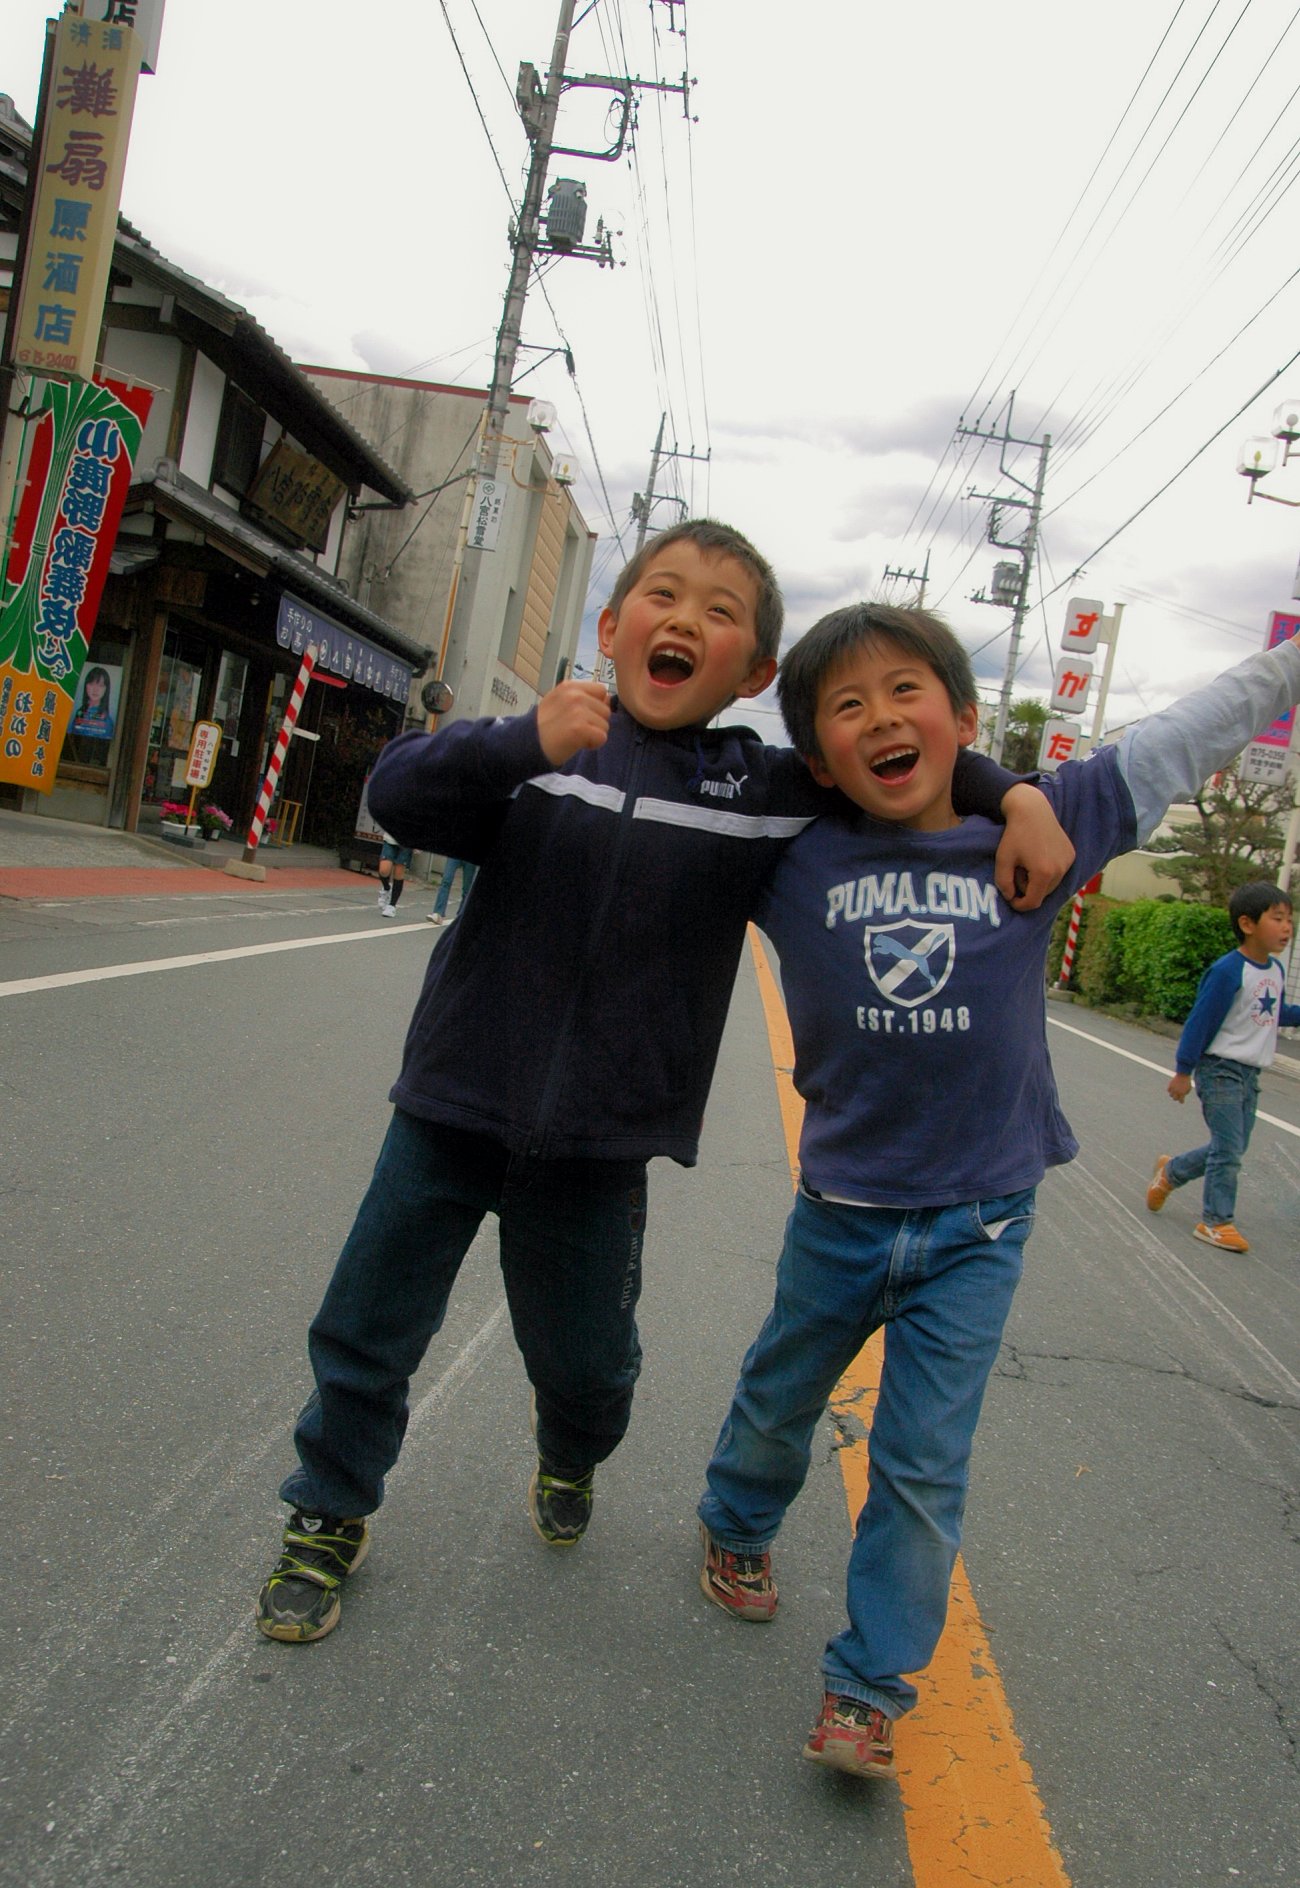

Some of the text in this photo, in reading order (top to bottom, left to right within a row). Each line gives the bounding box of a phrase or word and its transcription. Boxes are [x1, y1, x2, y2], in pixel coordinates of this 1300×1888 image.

[70, 22, 122, 51] 清酒
[700, 780, 735, 799] PUMA
[825, 871, 1001, 929] PUMA.COM
